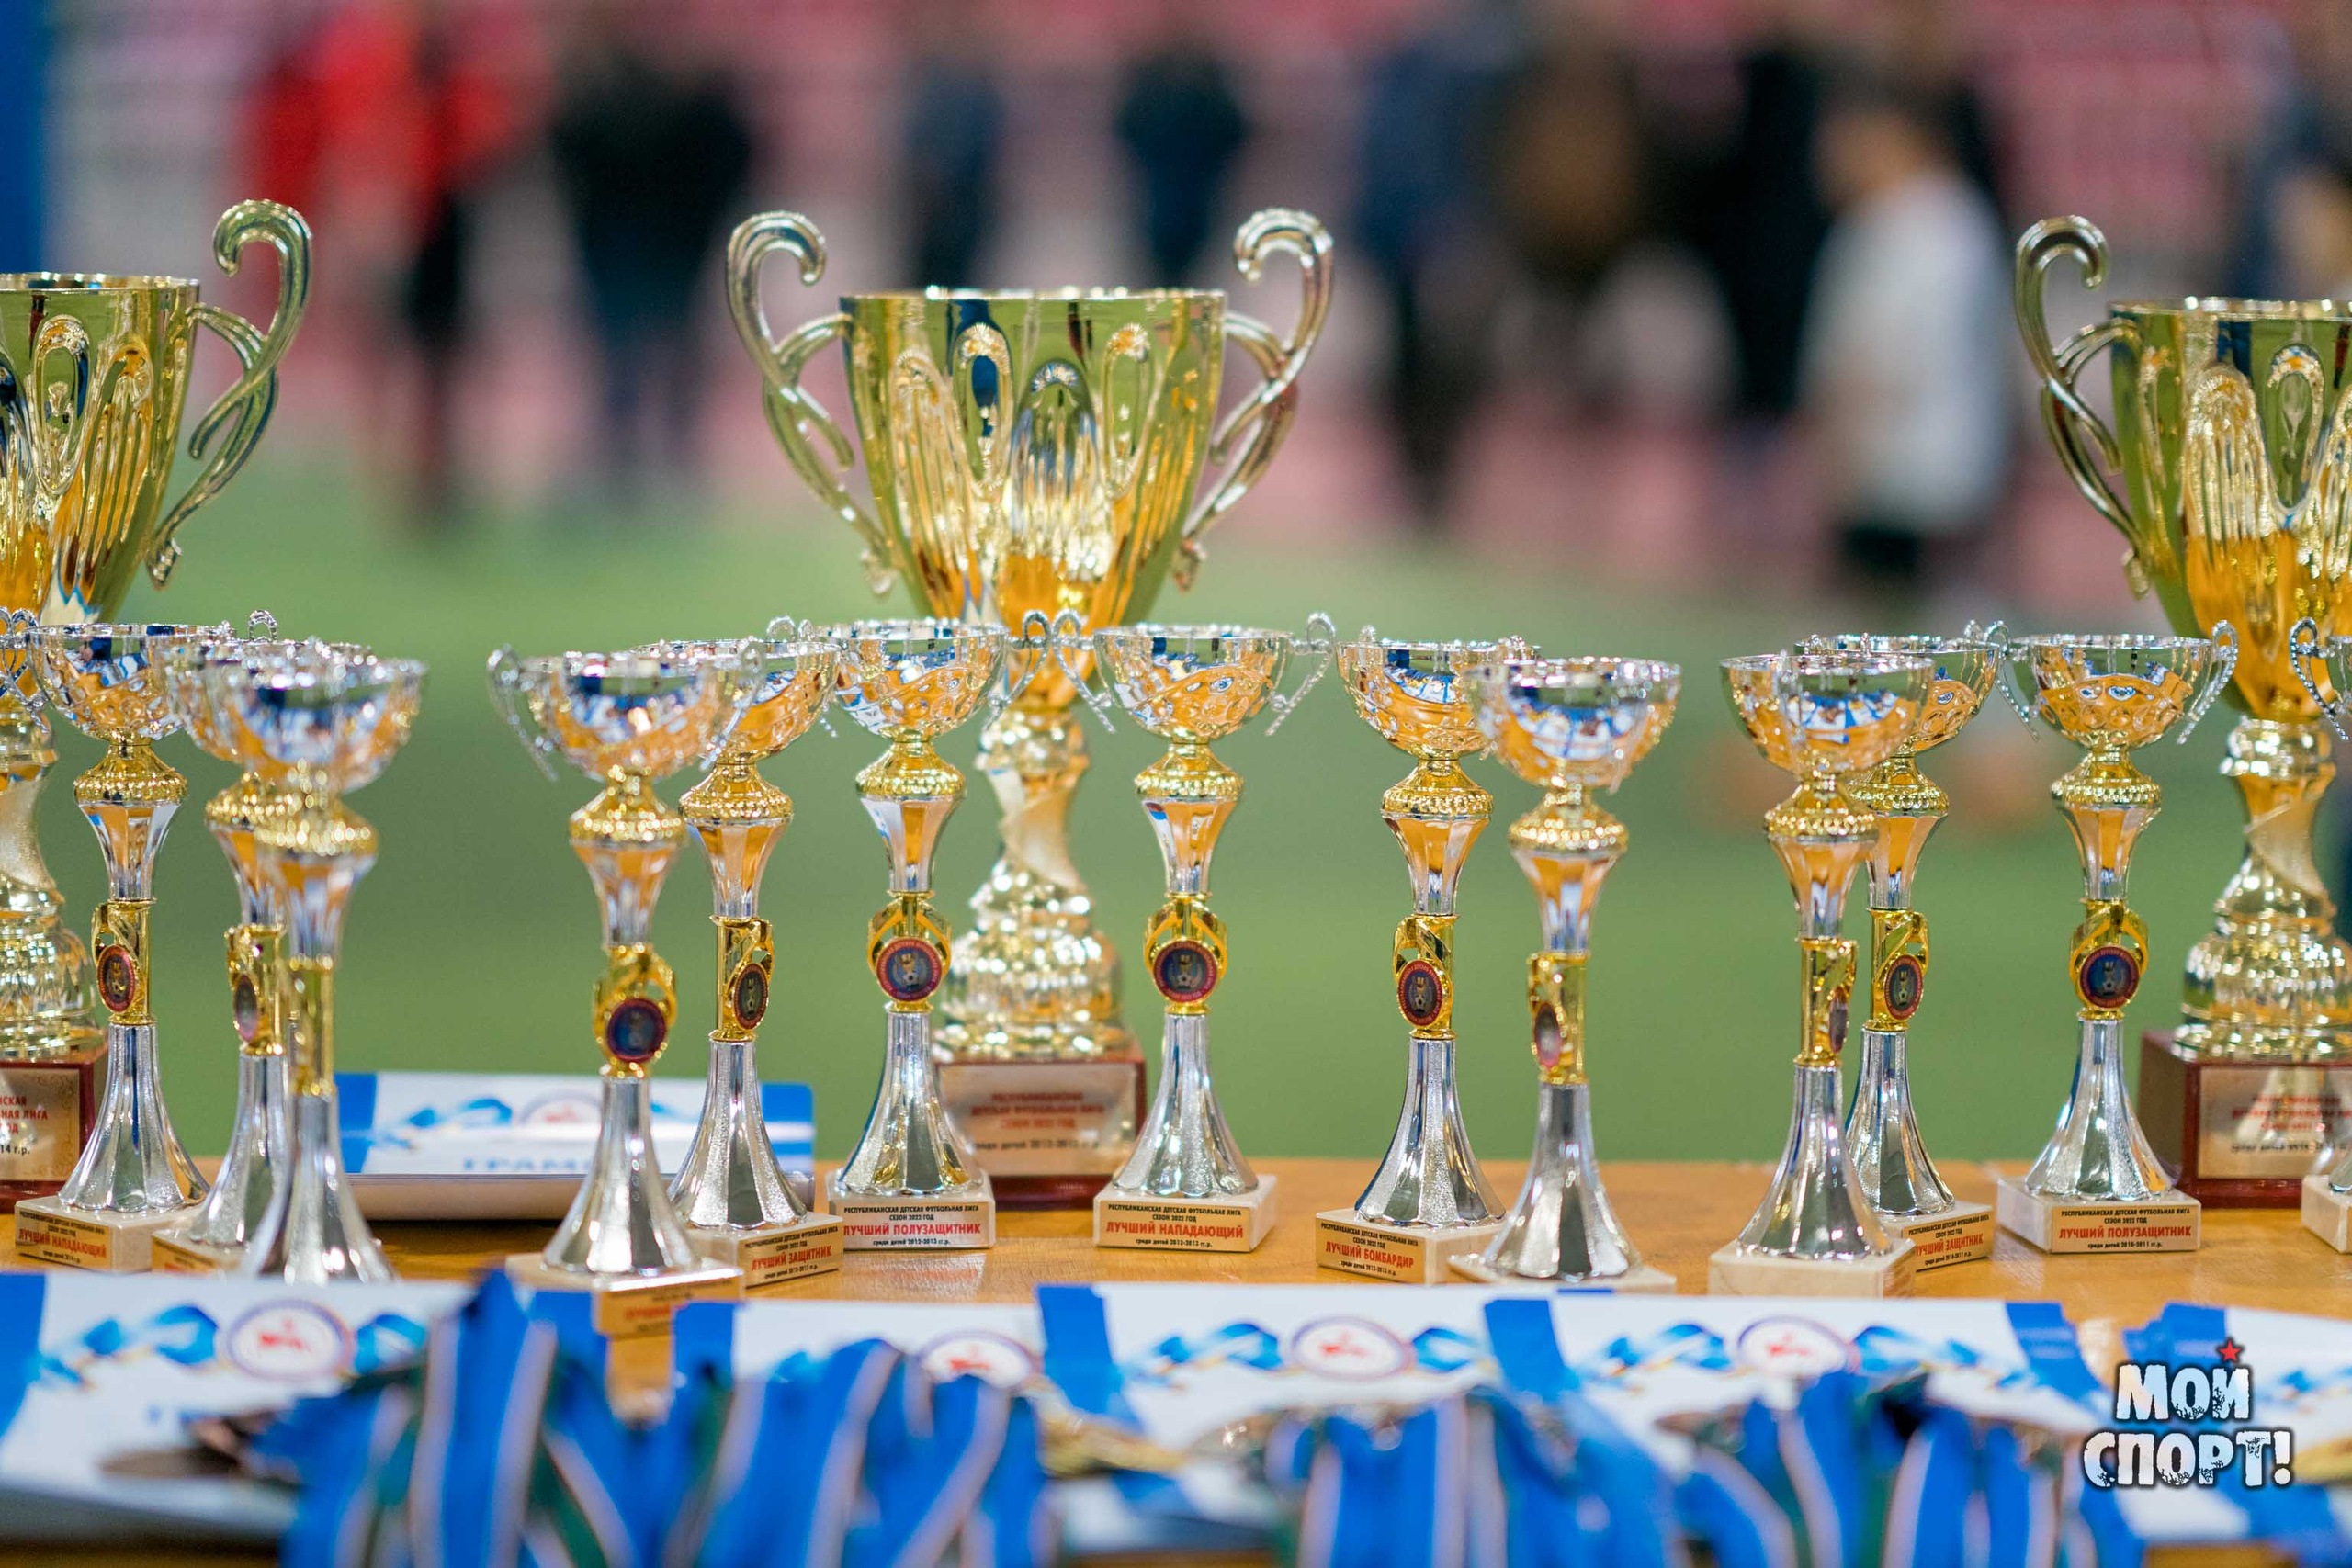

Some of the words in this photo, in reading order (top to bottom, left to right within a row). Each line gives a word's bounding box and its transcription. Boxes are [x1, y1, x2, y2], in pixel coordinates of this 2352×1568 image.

[23, 1110, 49, 1120] ЛИГА
[843, 1223, 889, 1235] ЛУЧШИЙ
[893, 1224, 980, 1235] ПОЛУЗАЩИТНИК
[1106, 1221, 1156, 1234] ЛУЧШИЙ
[1159, 1224, 1243, 1238] НАПАДАЮЩИЙ
[2059, 1225, 2104, 1239] ЛУЧШИЙ
[2108, 1226, 2191, 1238] ПОЛУЗАЩИТНИК
[1946, 1234, 1984, 1250] ЗАЩИТНИК
[752, 1251, 786, 1270] ЛУЧШИЙ
[788, 1246, 831, 1264] ЗАЩИТНИК
[1326, 1241, 1361, 1258] ЛУЧШИЙ
[1364, 1249, 1414, 1268] БОМБАРДИР
